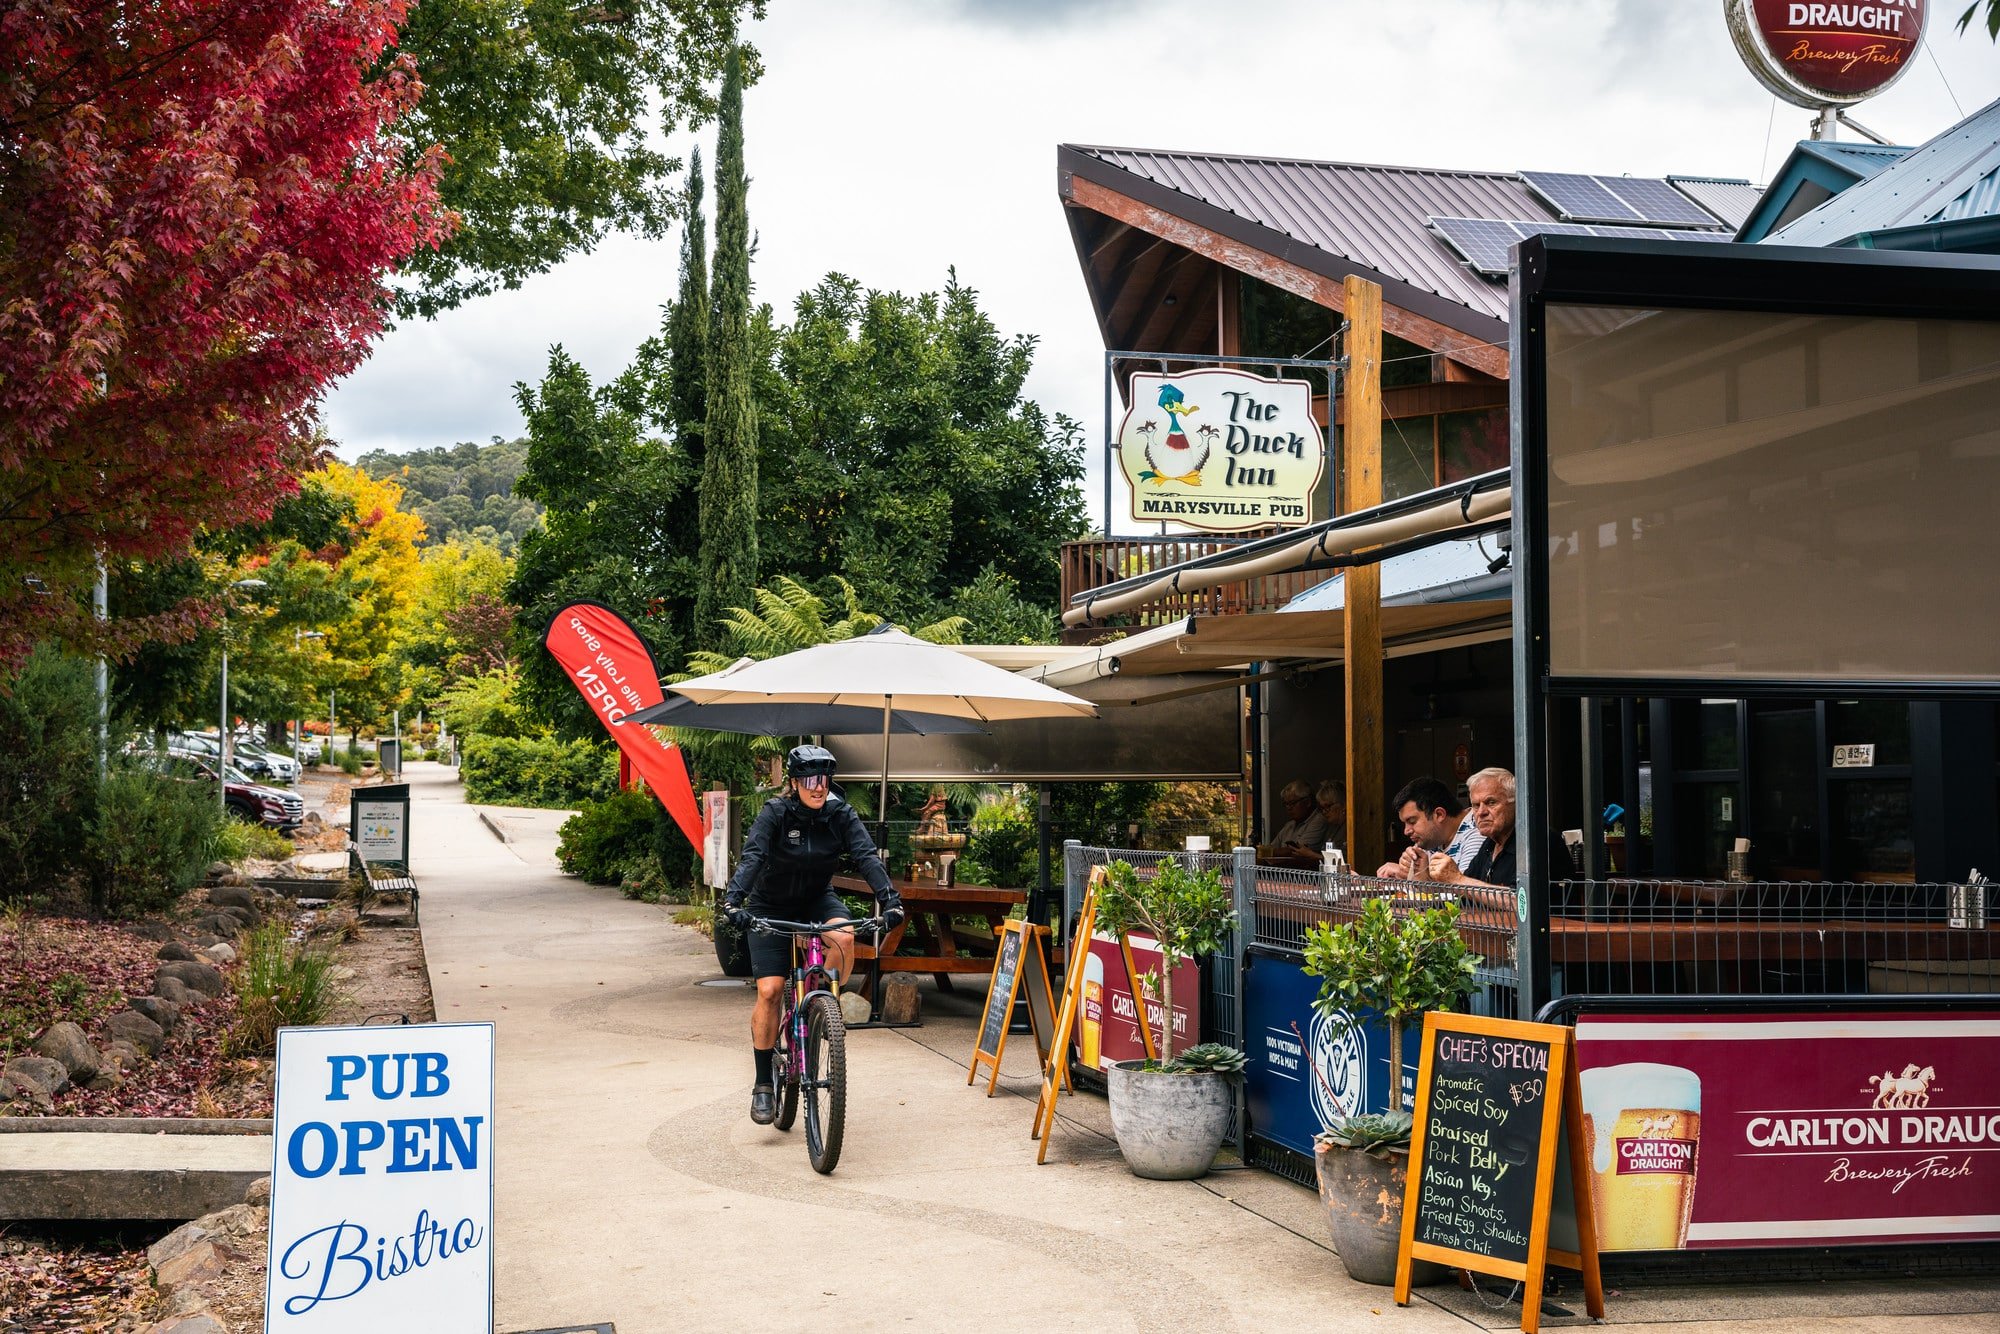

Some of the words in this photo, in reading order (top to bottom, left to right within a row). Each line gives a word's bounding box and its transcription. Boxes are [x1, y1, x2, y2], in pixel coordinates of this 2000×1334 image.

[1788, 3, 1904, 32] DRAUGHT
[1785, 39, 1860, 73] Brewery
[1860, 44, 1902, 65] Fresh
[1221, 391, 1280, 423] The
[1225, 424, 1305, 459] Duck
[1225, 456, 1276, 487] Inn
[1142, 500, 1261, 517] MARYSVILLE
[1269, 503, 1304, 518] PUB
[1147, 1004, 1187, 1033] DRAHT
[1277, 1038, 1302, 1056] VICTORIAN
[1284, 1056, 1298, 1070] MALT
[1440, 1036, 1488, 1063] CHEF'S
[1491, 1041, 1549, 1072] SPECIAL
[325, 1052, 451, 1101] PUB
[1436, 1074, 1484, 1094] Aromatic
[1508, 1078, 1543, 1107] $30
[1433, 1089, 1479, 1117] Spiced
[1483, 1098, 1509, 1127] Soy
[287, 1116, 484, 1179] OPEN
[1430, 1118, 1489, 1147] Braised
[1745, 1117, 1890, 1147] CARLTON
[1429, 1141, 1460, 1165] Pork
[1469, 1146, 1509, 1181] Belly
[1620, 1142, 1691, 1159] CARLTON
[1630, 1158, 1684, 1170] DRAUGHT
[1425, 1165, 1464, 1189] Asian
[1824, 1157, 1914, 1194] Brewery
[1914, 1155, 1973, 1179] Fresh
[1424, 1186, 1454, 1208] Bean
[1460, 1195, 1507, 1224] Shoots,
[1421, 1204, 1452, 1225] Fried
[1482, 1221, 1528, 1246] Shallots
[1432, 1226, 1460, 1247] Fresh
[280, 1209, 484, 1316] Bistro
